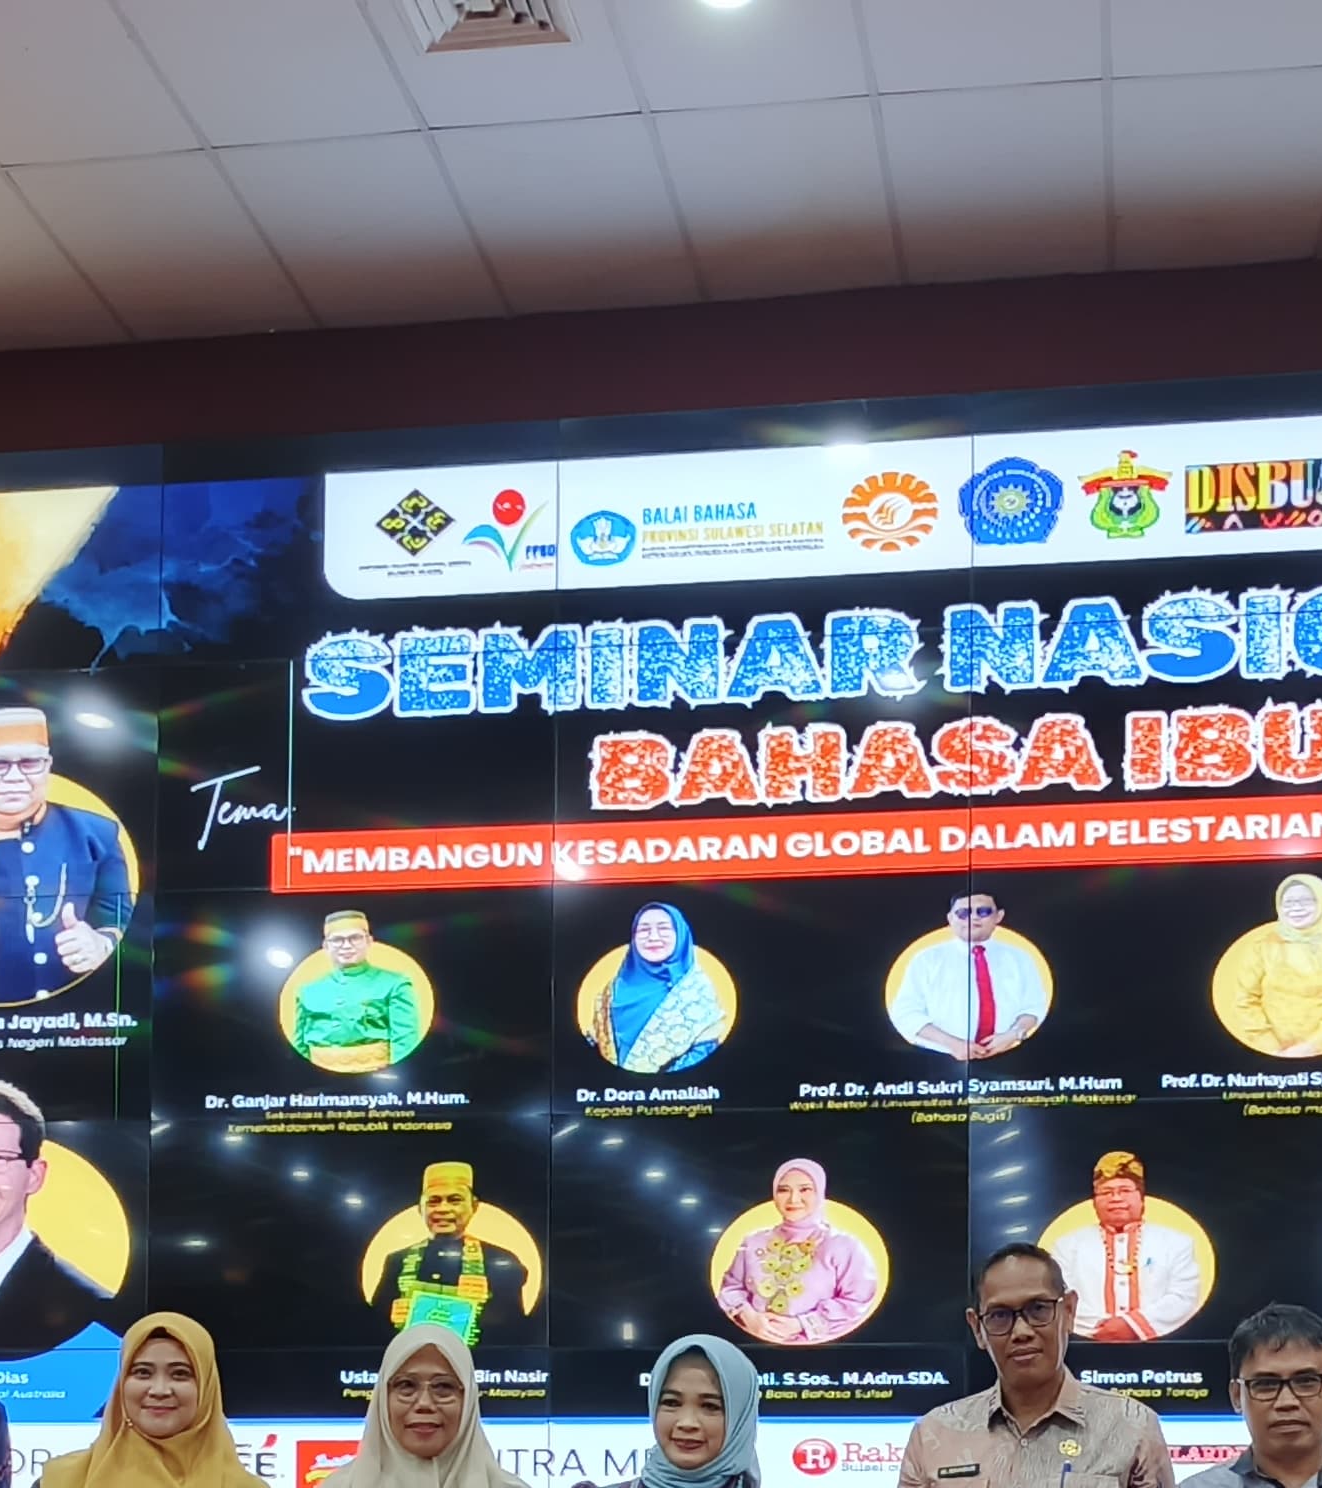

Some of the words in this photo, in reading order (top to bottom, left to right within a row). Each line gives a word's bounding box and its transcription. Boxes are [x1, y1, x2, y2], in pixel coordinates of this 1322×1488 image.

[643, 506, 688, 525] BALAI
[694, 502, 757, 522] BAHASA
[642, 528, 698, 543] PROVINSI
[703, 525, 764, 541] SULAWESI
[769, 521, 823, 537] SELATAN
[302, 607, 928, 721] SEMINAR
[590, 712, 1113, 812] BAHASA
[290, 844, 543, 874] "MEMBANGUN
[553, 834, 776, 869] KESADARAN
[785, 827, 932, 858] GLOBAL
[940, 820, 1075, 852] DALAM
[7, 1013, 80, 1033] Jayadi,
[83, 1013, 137, 1028] M.Sn.
[7, 1037, 54, 1051] Negeri
[58, 1035, 127, 1048] Makassar
[799, 1084, 841, 1097] Prof.
[845, 1083, 870, 1096] Dr.
[873, 1081, 913, 1095] Andi
[917, 1080, 963, 1094] Sukri
[968, 1079, 1054, 1096] Syamsuri,
[1059, 1077, 1123, 1090] M.Hum
[1161, 1074, 1199, 1088] Prof.
[1201, 1074, 1226, 1087] Dr.
[1227, 1072, 1309, 1089] Nurhayati
[205, 1095, 229, 1108] Dr.
[231, 1094, 285, 1110] Ganjar
[289, 1092, 402, 1109] Harimansyah,
[406, 1091, 469, 1105] M.Hum.
[577, 1089, 600, 1102] Dr.
[604, 1087, 646, 1101] Dora
[649, 1085, 720, 1101] Amaliah
[504, 1369, 549, 1383] Nasir
[1080, 1370, 1139, 1384] Simon
[1142, 1370, 1203, 1384] Petrus
